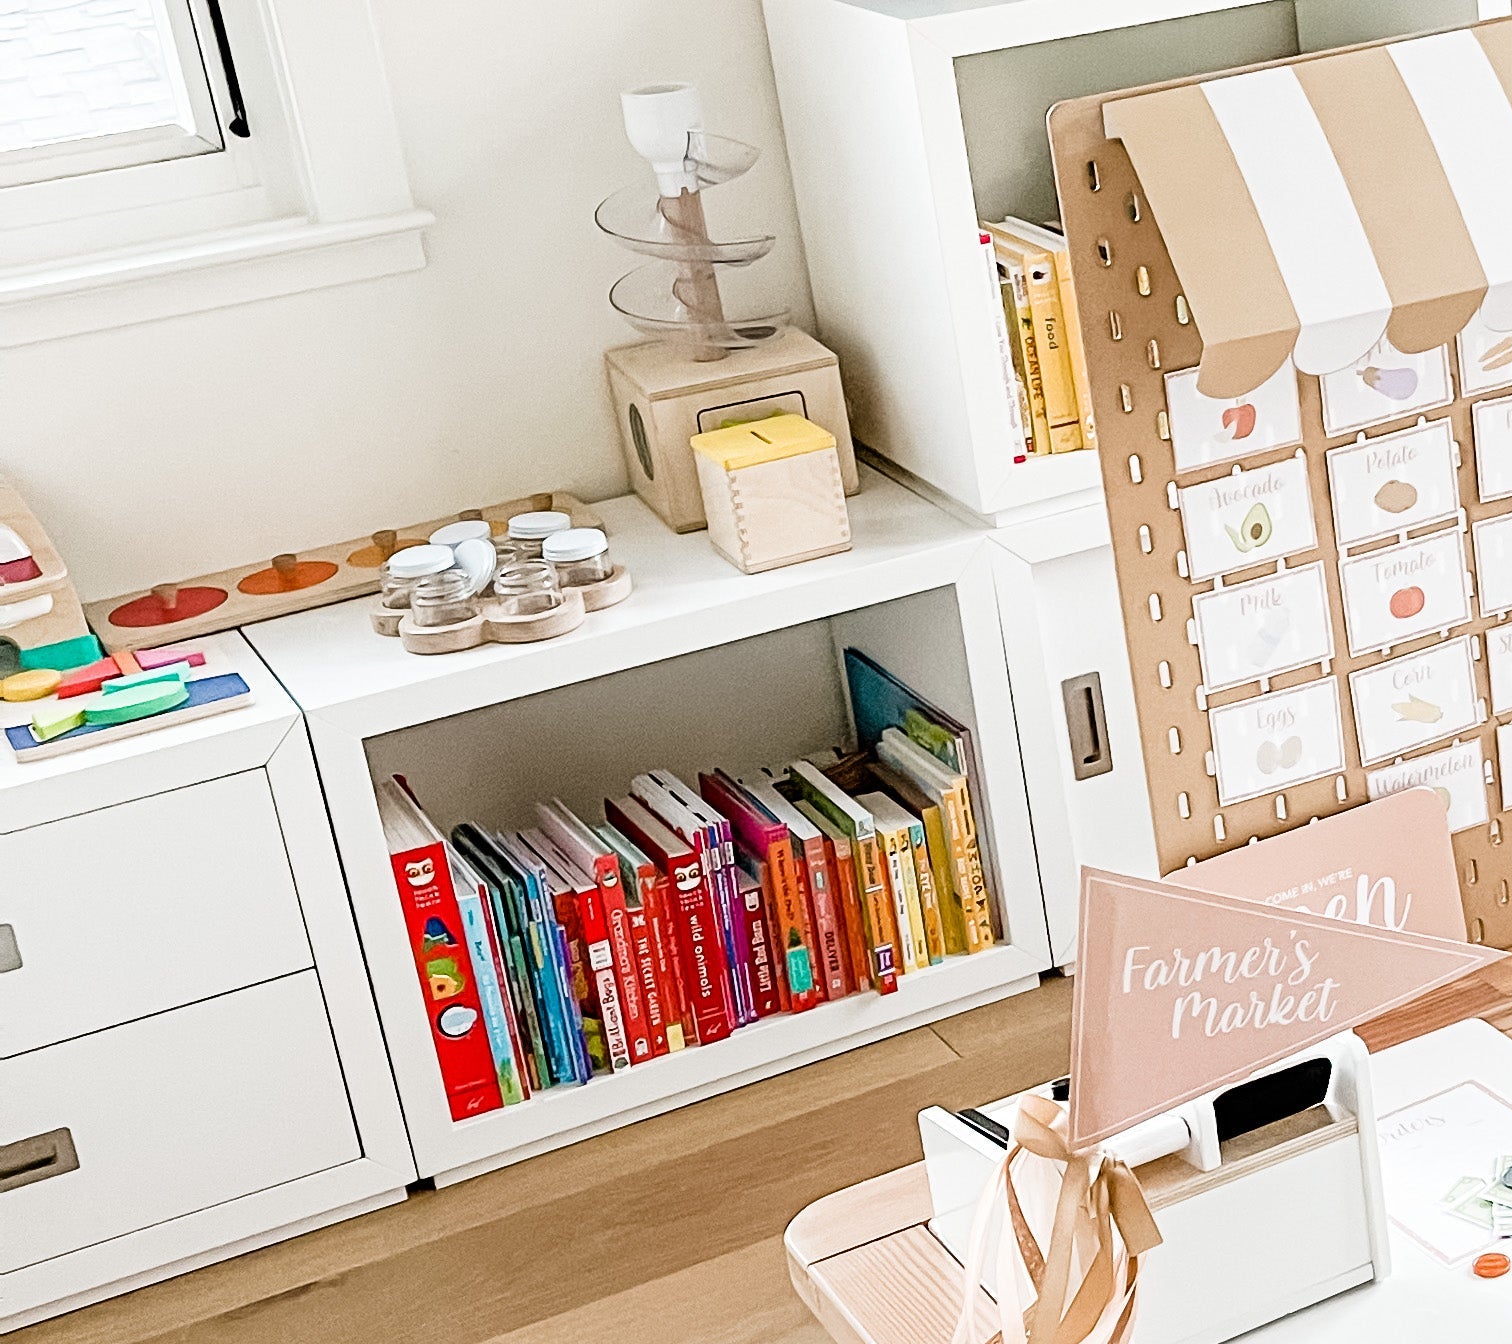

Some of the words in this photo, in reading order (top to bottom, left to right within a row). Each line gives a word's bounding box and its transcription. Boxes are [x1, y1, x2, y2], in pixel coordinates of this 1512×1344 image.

[1044, 317, 1059, 351] food
[1366, 444, 1418, 474] Potato
[1211, 474, 1284, 509] Avocado
[1372, 550, 1437, 583] Tomato
[1239, 586, 1284, 616] Milk
[1255, 703, 1296, 733] Eggs
[1264, 886, 1299, 906] COME
[1318, 867, 1354, 887] WE'RE
[689, 914, 704, 942] wild
[752, 920, 766, 944] Barn
[636, 937, 649, 954] THE
[755, 945, 769, 964] Red
[611, 909, 632, 973] Grandma's
[623, 975, 641, 1021] Kitchen
[640, 957, 656, 990] SECRET
[694, 946, 712, 998] animals
[1122, 930, 1320, 995] Farmer's
[758, 966, 772, 993] Little
[647, 991, 661, 1026] GARDEN
[1171, 977, 1342, 1040] Market
